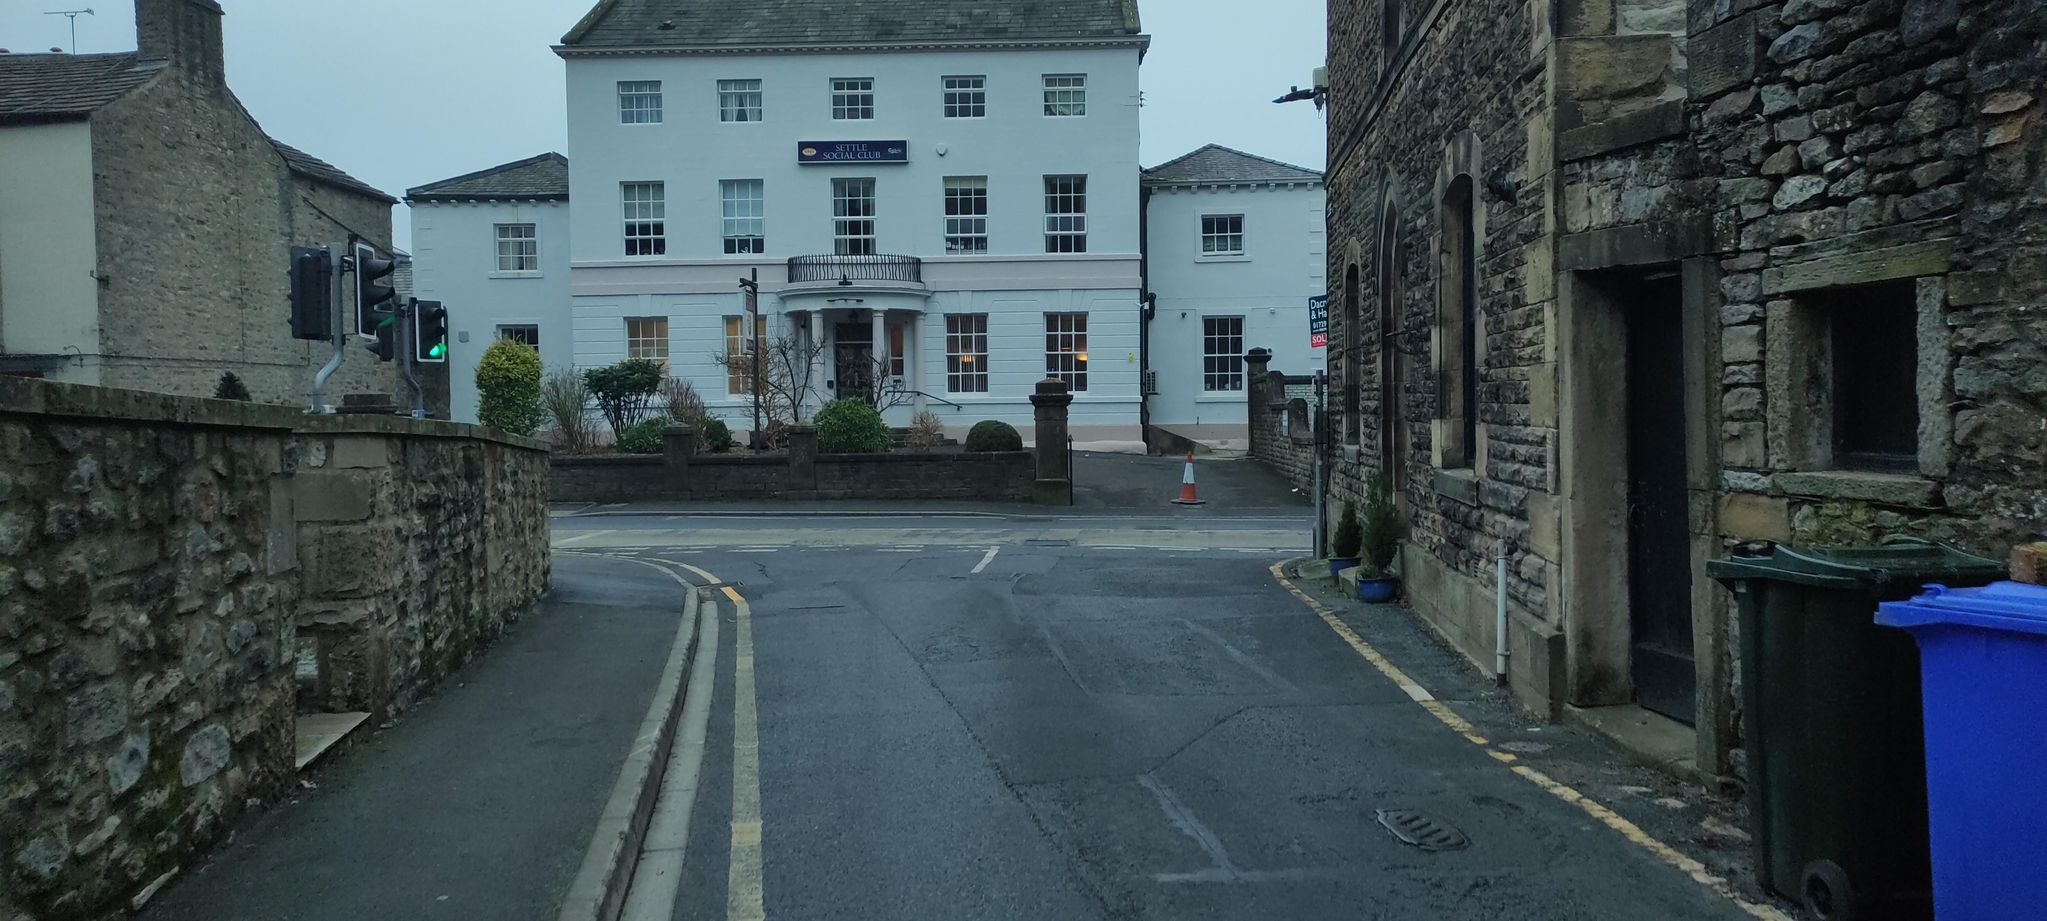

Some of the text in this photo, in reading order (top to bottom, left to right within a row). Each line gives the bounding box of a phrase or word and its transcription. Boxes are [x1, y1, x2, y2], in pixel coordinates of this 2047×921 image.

[835, 143, 868, 152] SETTLE
[823, 151, 856, 160] SOCIAL
[857, 151, 881, 159] CLUB
[1311, 310, 1317, 320] &
